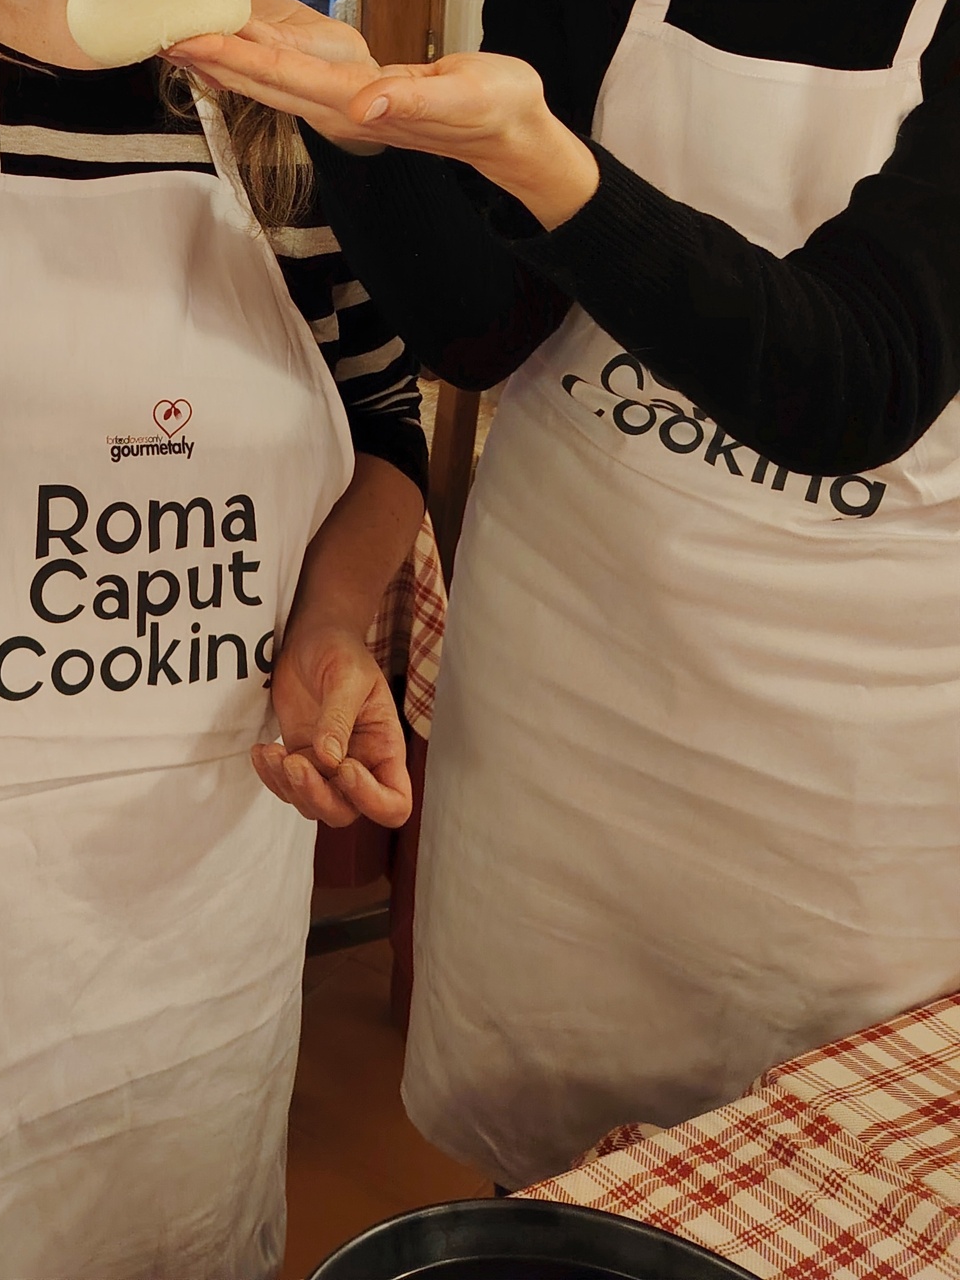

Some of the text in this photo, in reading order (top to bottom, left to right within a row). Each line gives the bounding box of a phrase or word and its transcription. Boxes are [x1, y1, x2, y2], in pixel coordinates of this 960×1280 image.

[110, 436, 195, 463] gourmetaly
[35, 484, 258, 560] Roma
[30, 551, 263, 638] Caput
